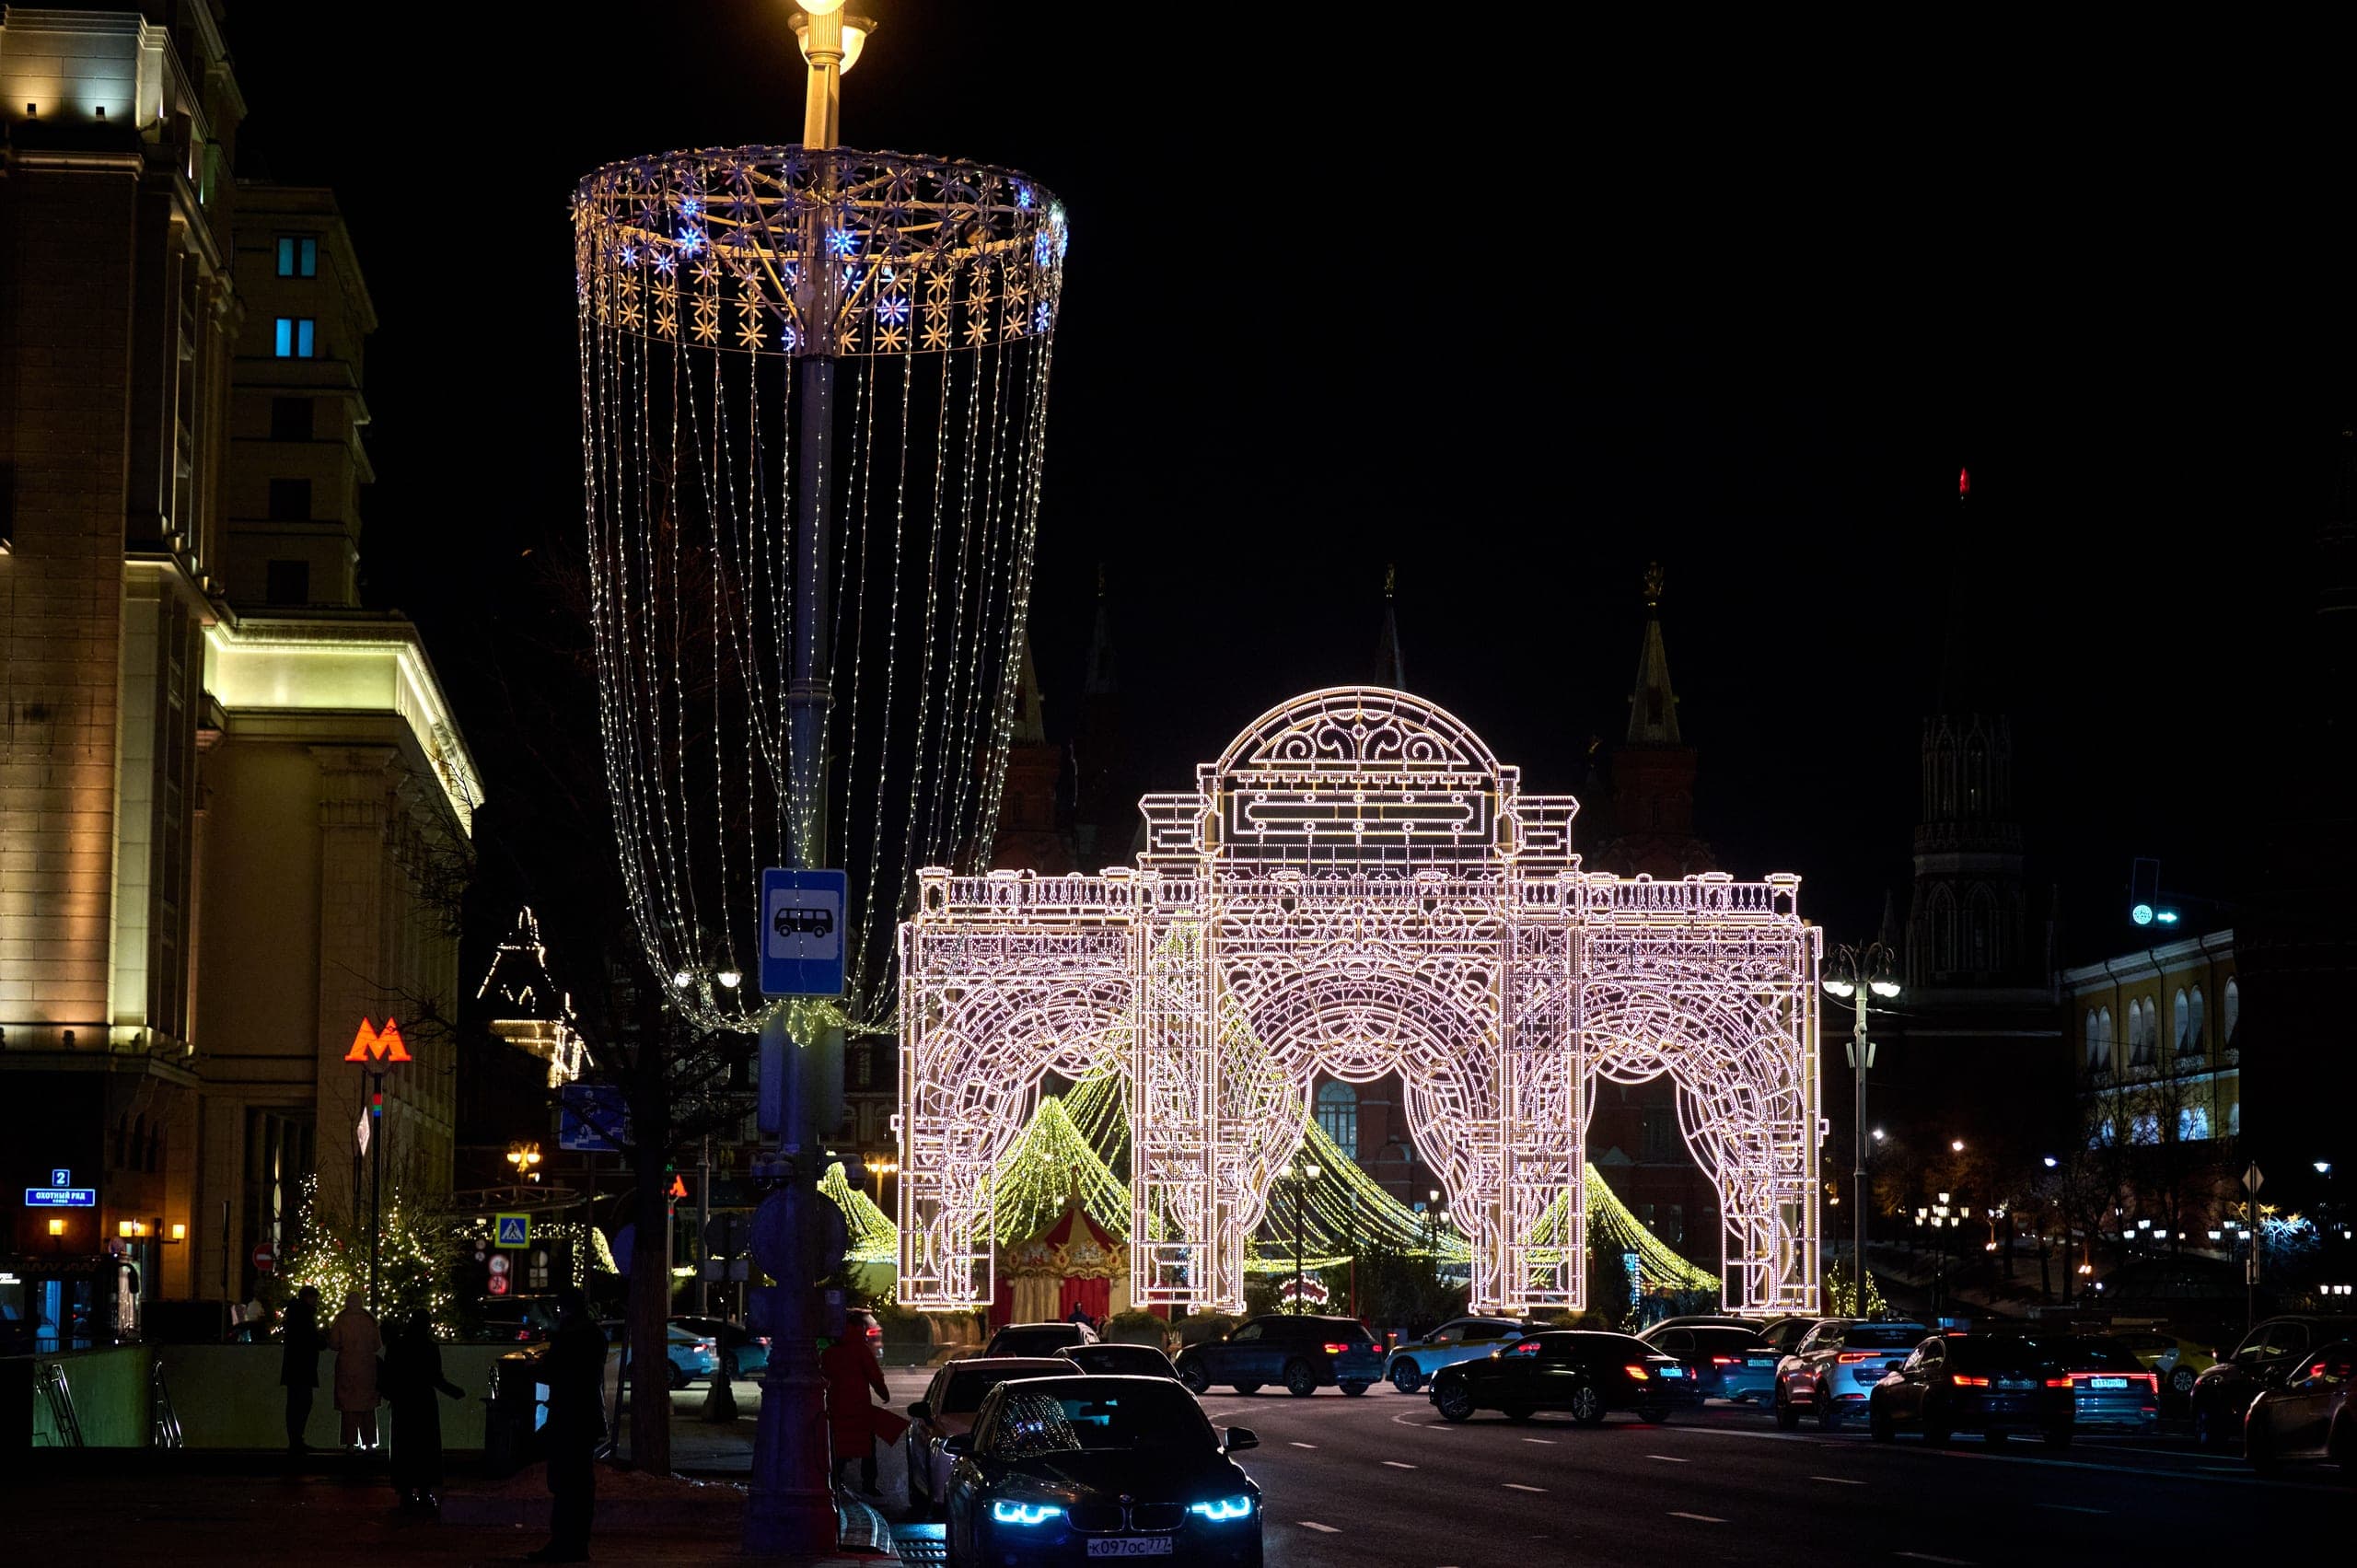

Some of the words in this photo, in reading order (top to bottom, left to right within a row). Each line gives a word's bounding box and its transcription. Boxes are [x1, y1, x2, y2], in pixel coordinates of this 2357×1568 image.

[344, 1016, 412, 1062] М
[56, 1172, 65, 1185] 2
[36, 1191, 70, 1200] ОХОТНЫЙ
